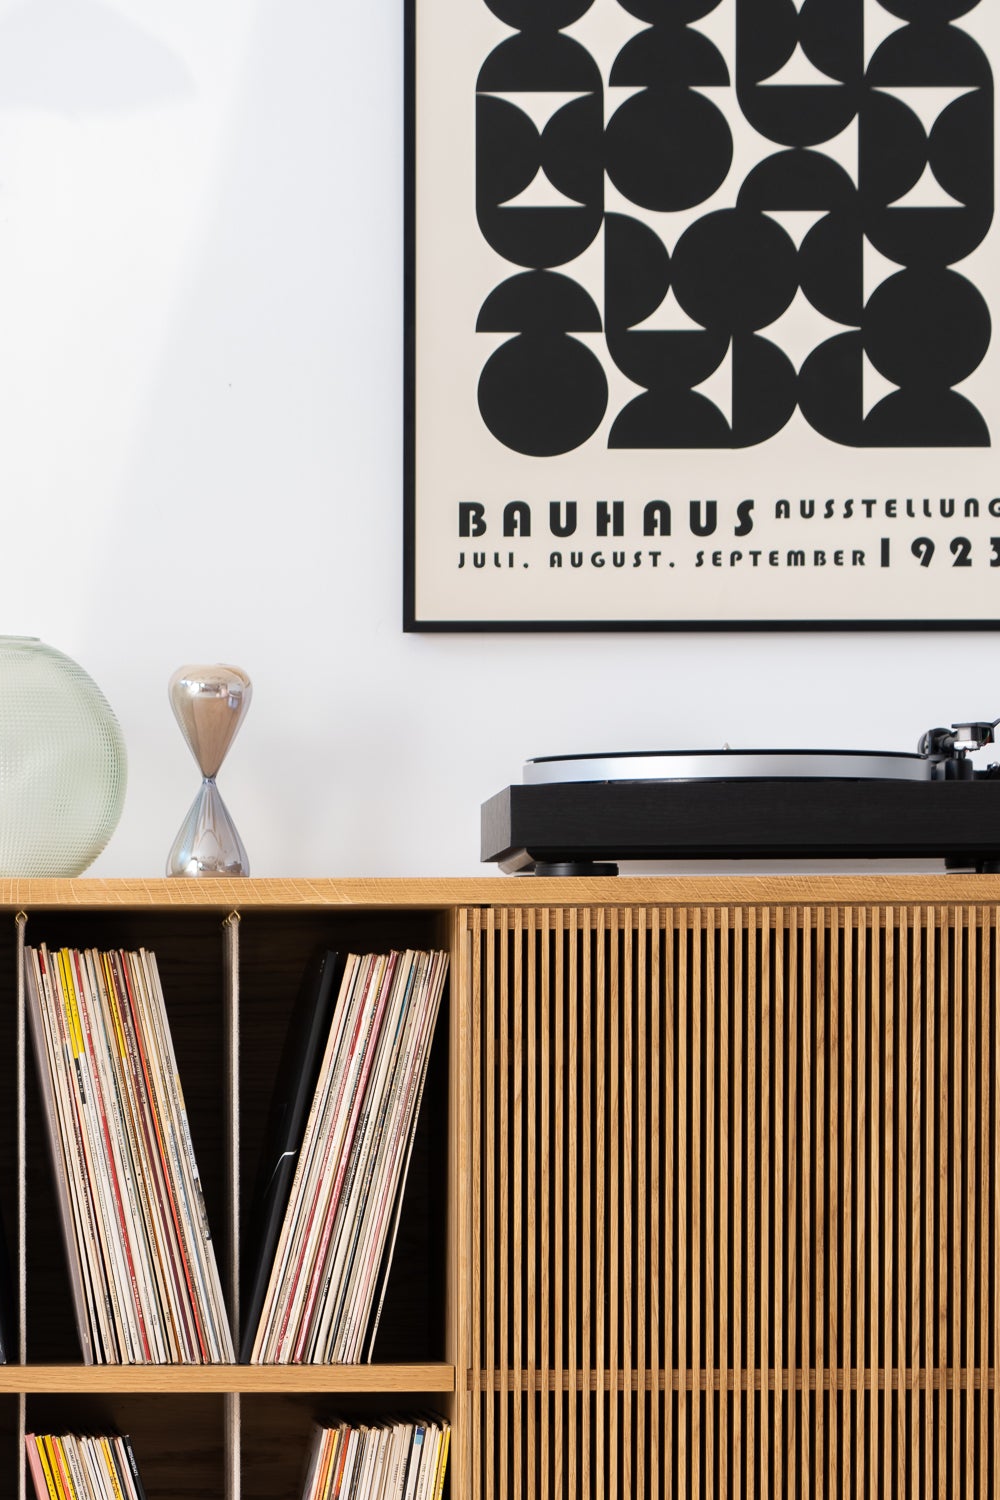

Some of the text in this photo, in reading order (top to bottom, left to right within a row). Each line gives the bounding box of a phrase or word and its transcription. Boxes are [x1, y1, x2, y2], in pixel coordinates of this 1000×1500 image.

[458, 497, 1000, 538] BAUHAUS AUSSTELLUNG
[457, 551, 530, 569] JULI.
[549, 550, 676, 569] AUGUST.
[694, 549, 867, 568] SEPTEMBER
[311, 1089, 320, 1113] STEREO
[68, 1446, 76, 1464] HELMUT
